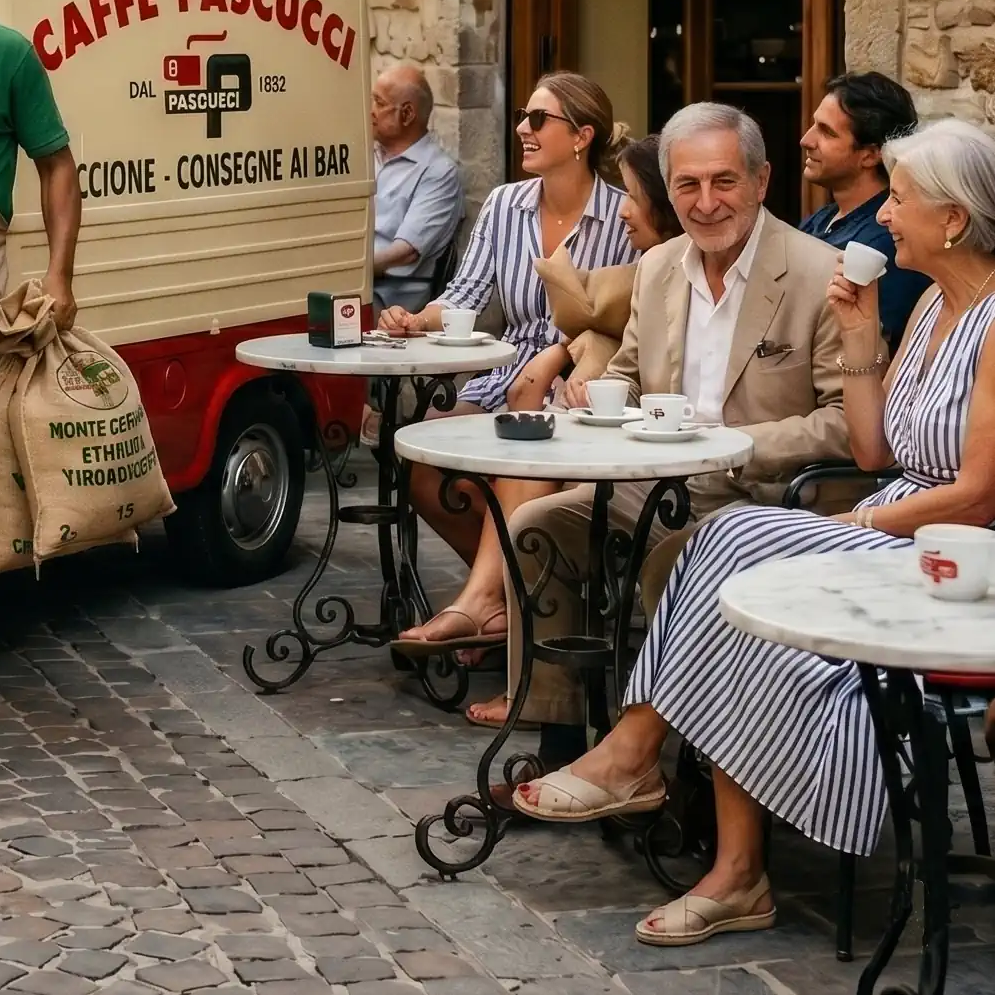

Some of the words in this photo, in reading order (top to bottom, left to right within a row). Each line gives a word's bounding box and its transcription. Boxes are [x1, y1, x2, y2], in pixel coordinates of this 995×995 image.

[130, 81, 156, 99] DAL
[259, 76, 286, 93] 1832
[177, 148, 283, 190] CONSEGNE
[290, 146, 307, 179] AI
[315, 144, 350, 177] BAR
[49, 420, 106, 439] MONTE
